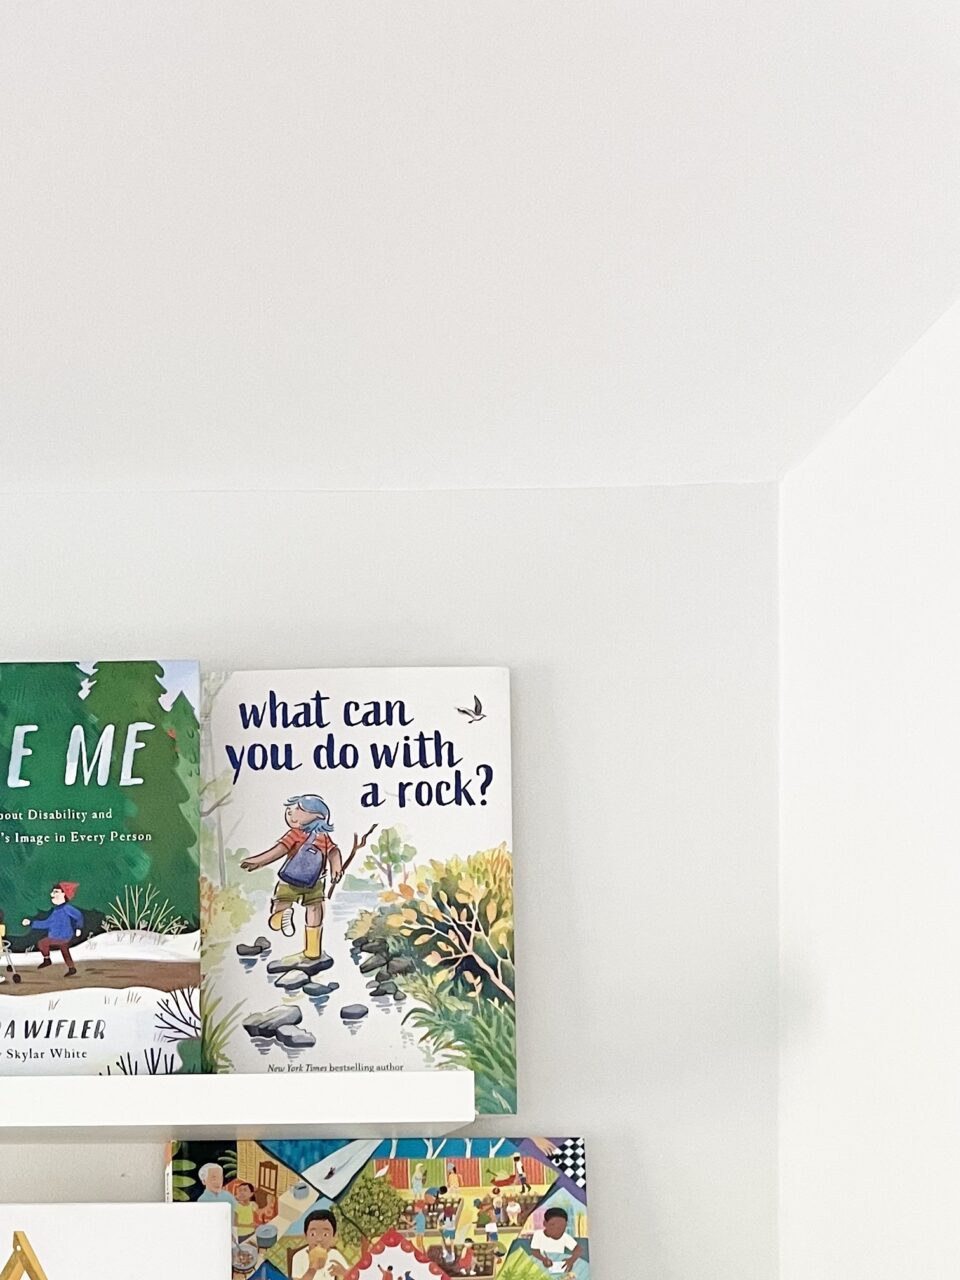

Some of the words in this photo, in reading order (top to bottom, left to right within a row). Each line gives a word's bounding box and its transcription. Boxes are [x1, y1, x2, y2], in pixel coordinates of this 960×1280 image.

[238, 690, 331, 729] what
[343, 698, 414, 727] can
[65, 722, 156, 788] ME
[225, 742, 302, 785] you
[313, 734, 359, 770] do
[370, 730, 462, 769] with
[360, 781, 386, 807] a
[398, 764, 493, 807] rock?
[27, 809, 87, 822] Disability
[92, 809, 113, 819] and
[15, 832, 50, 845] Image
[54, 832, 65, 842] in
[70, 831, 105, 844] Every
[110, 831, 152, 842] Person
[24, 1019, 106, 1040] WIFLER
[6, 1048, 46, 1062] Skylar
[50, 1047, 87, 1059] White
[267, 1064, 285, 1072] New
[287, 1064, 303, 1072] York
[305, 1064, 328, 1072] Times
[329, 1063, 374, 1072] bestselling
[376, 1062, 404, 1072] author
